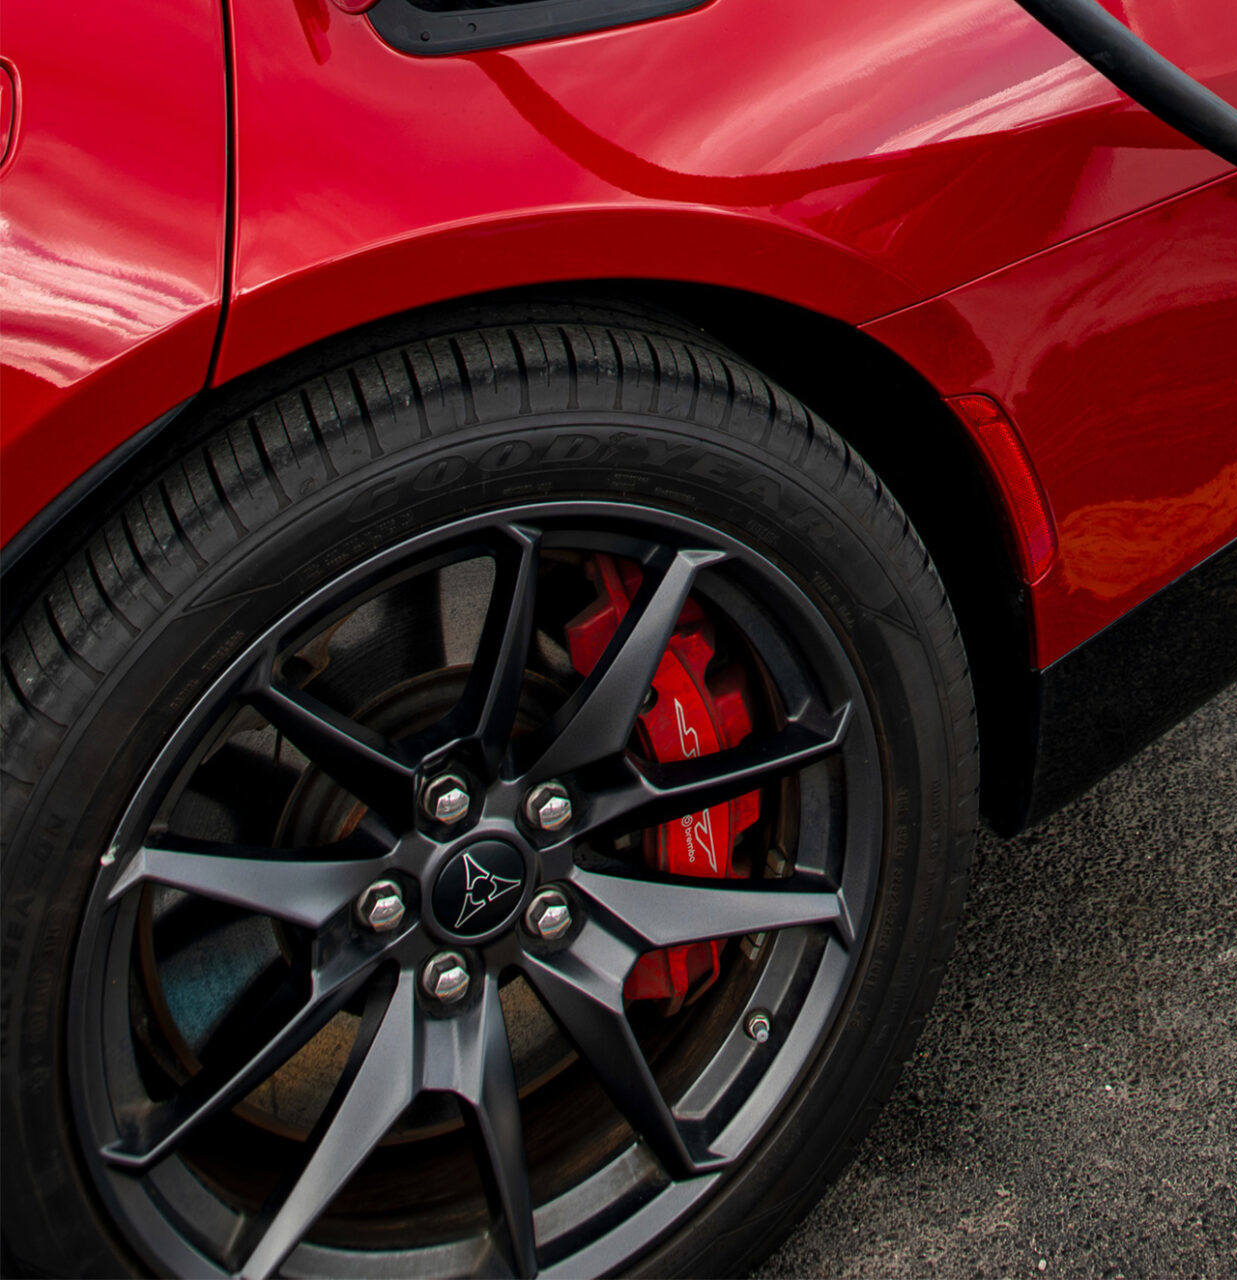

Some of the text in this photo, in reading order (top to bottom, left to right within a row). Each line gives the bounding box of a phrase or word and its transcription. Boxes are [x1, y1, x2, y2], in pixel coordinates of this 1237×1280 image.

[347, 431, 836, 541] GOODYEAR
[674, 698, 717, 873] ST
[684, 826, 696, 863] brembo
